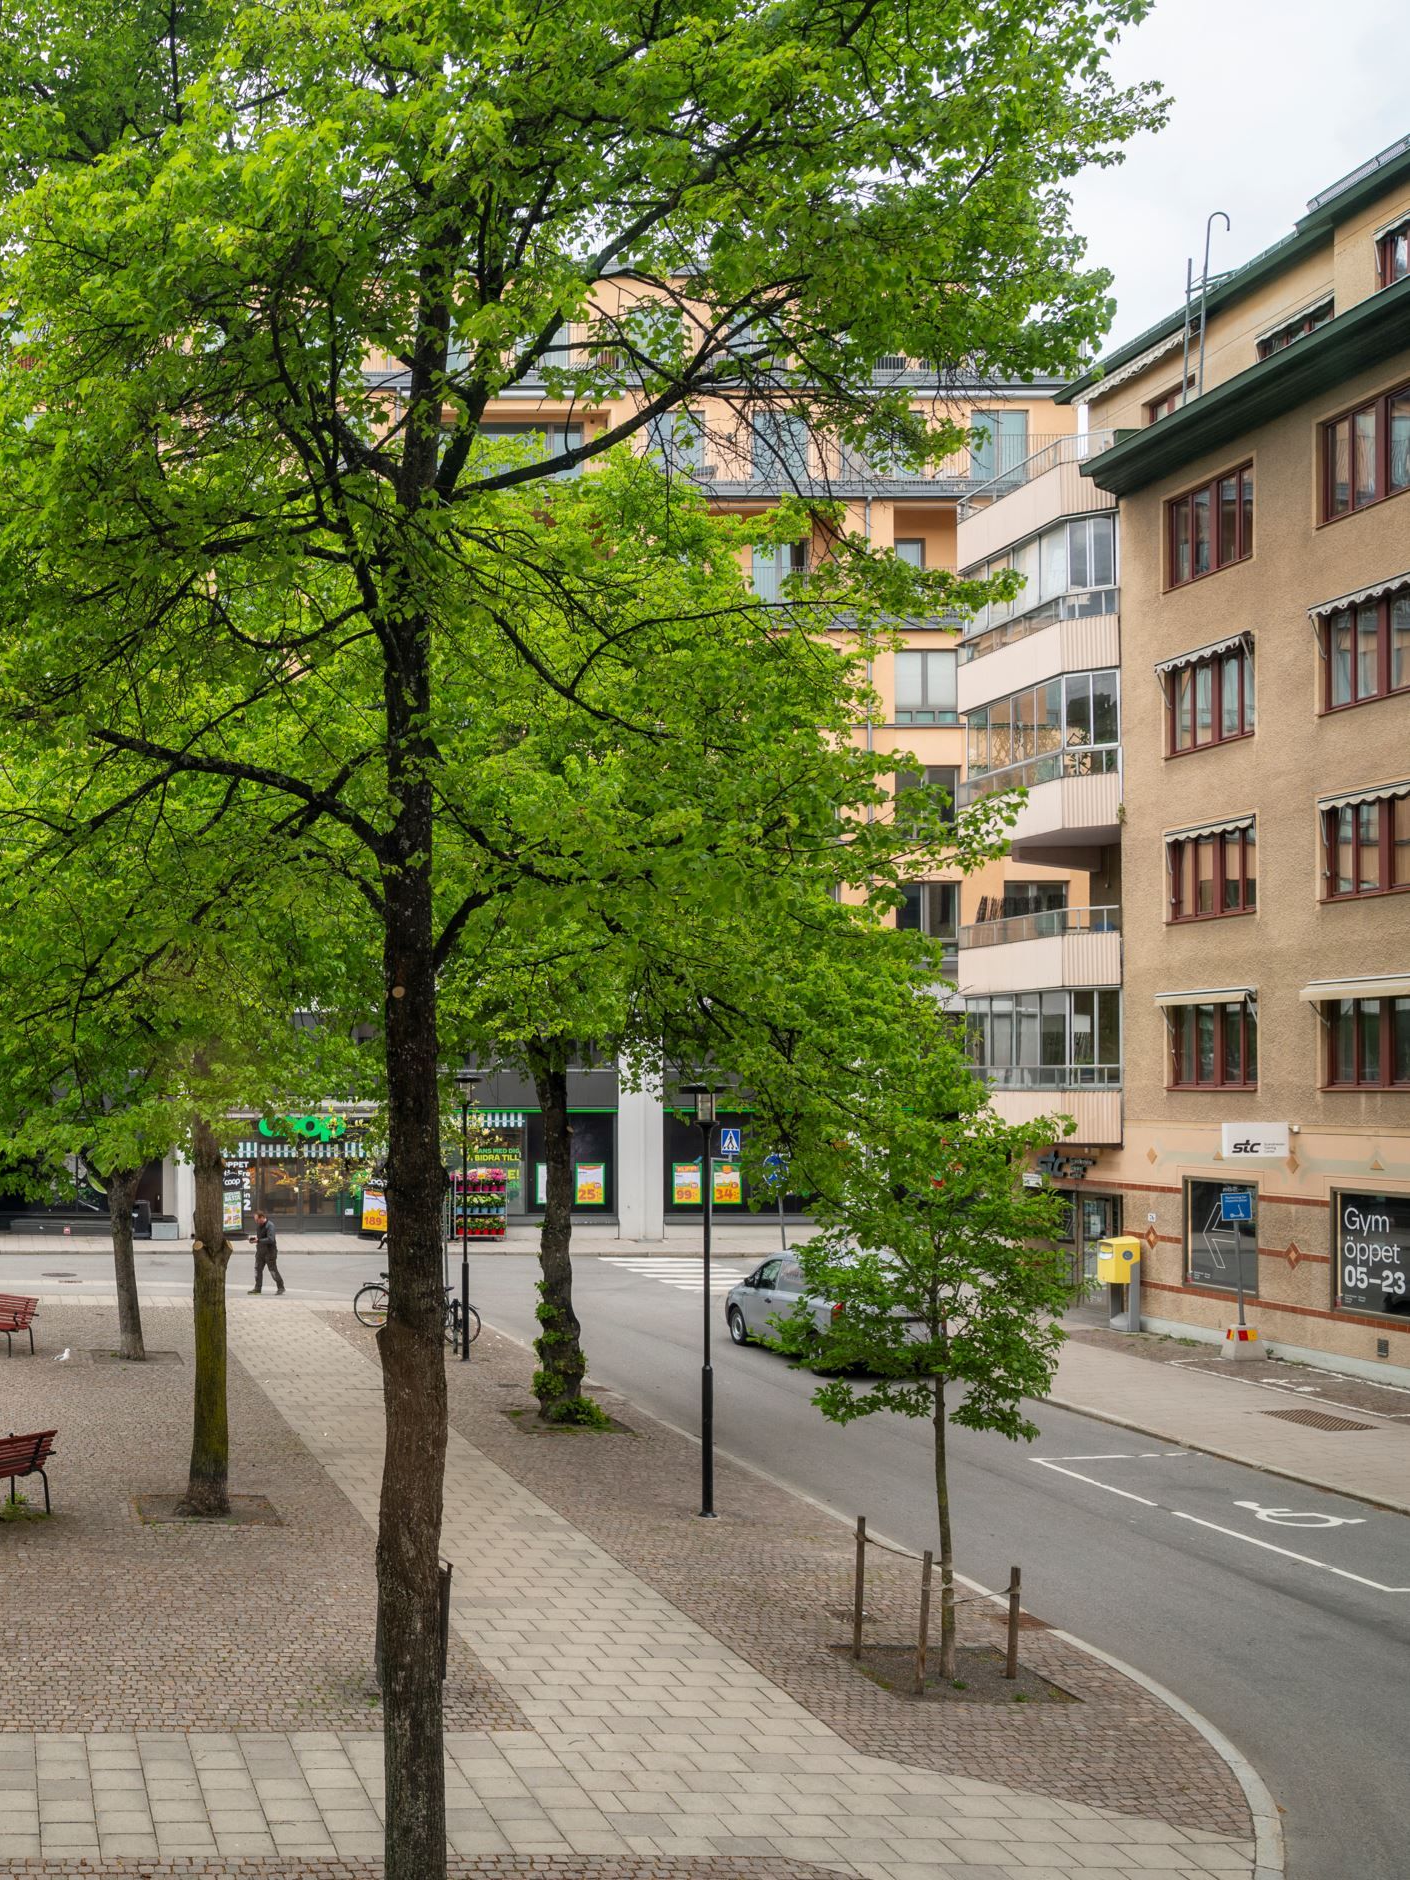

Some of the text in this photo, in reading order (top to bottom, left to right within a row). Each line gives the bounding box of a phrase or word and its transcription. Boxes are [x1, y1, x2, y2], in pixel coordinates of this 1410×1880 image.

[1232, 1139, 1261, 1153] stc
[474, 1154, 501, 1162] BIDRA
[501, 1154, 520, 1162] TILL
[223, 1178, 241, 1187] coop
[1344, 1207, 1390, 1237] Gym
[1344, 1235, 1401, 1267] öppet
